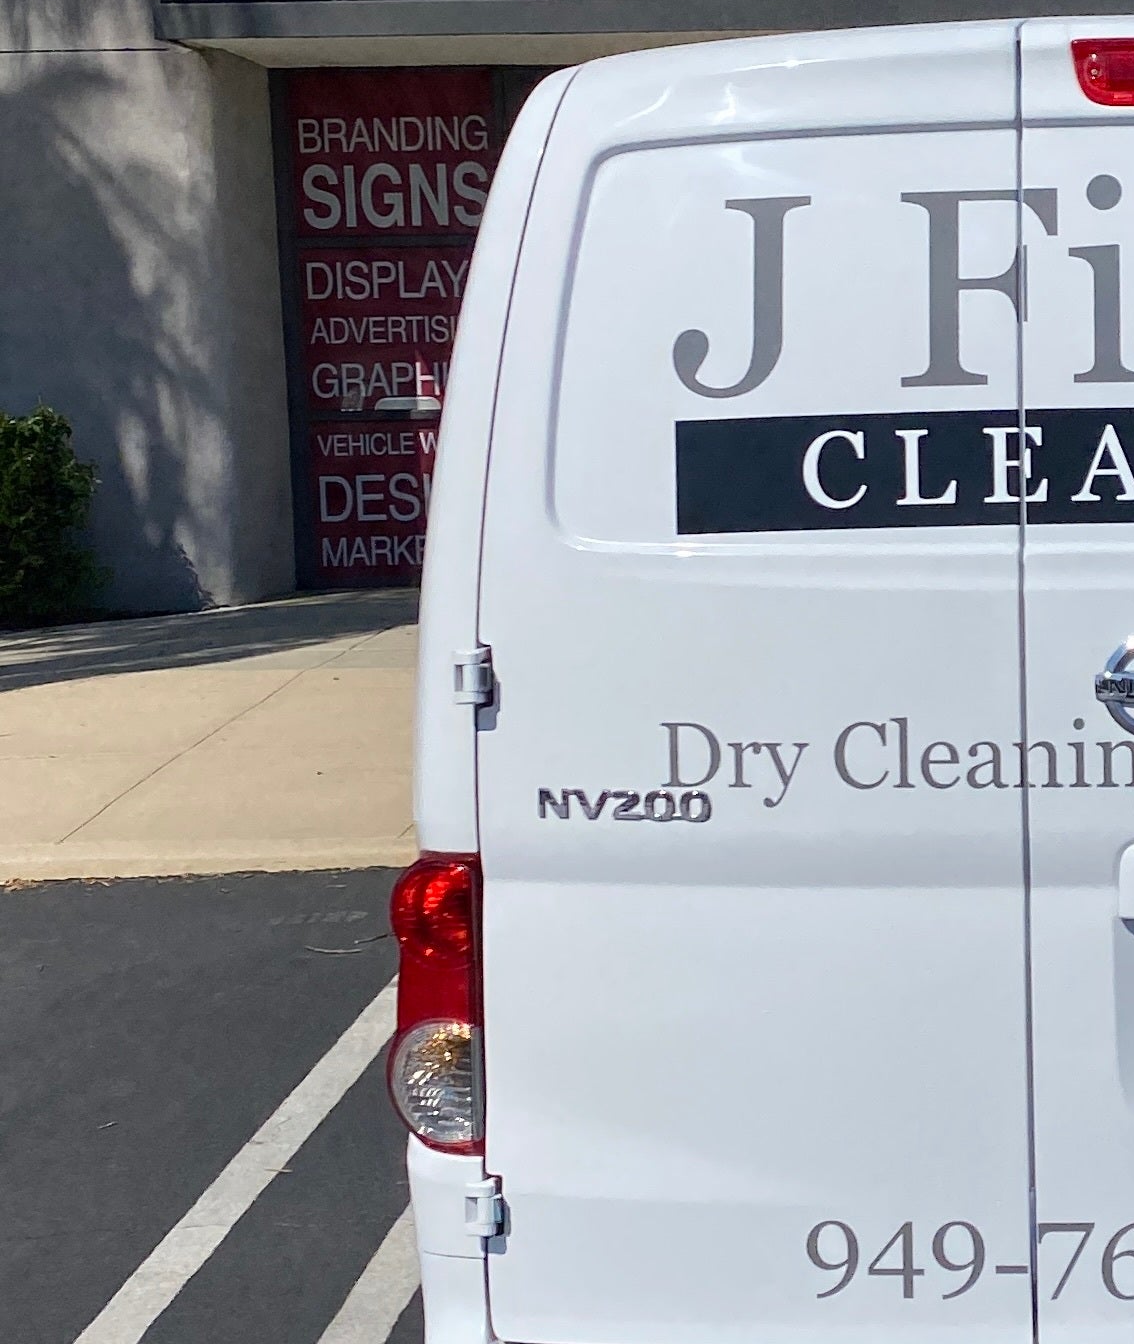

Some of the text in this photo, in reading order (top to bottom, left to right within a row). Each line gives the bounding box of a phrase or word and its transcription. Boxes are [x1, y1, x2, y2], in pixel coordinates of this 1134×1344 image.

[298, 115, 489, 154] BRANDING
[303, 160, 489, 229] SIGNS
[307, 259, 468, 299] DISPLAY
[672, 195, 811, 399] J
[317, 432, 415, 456] VEHICLE
[659, 722, 809, 808] Dry
[537, 788, 712, 823] NV200
